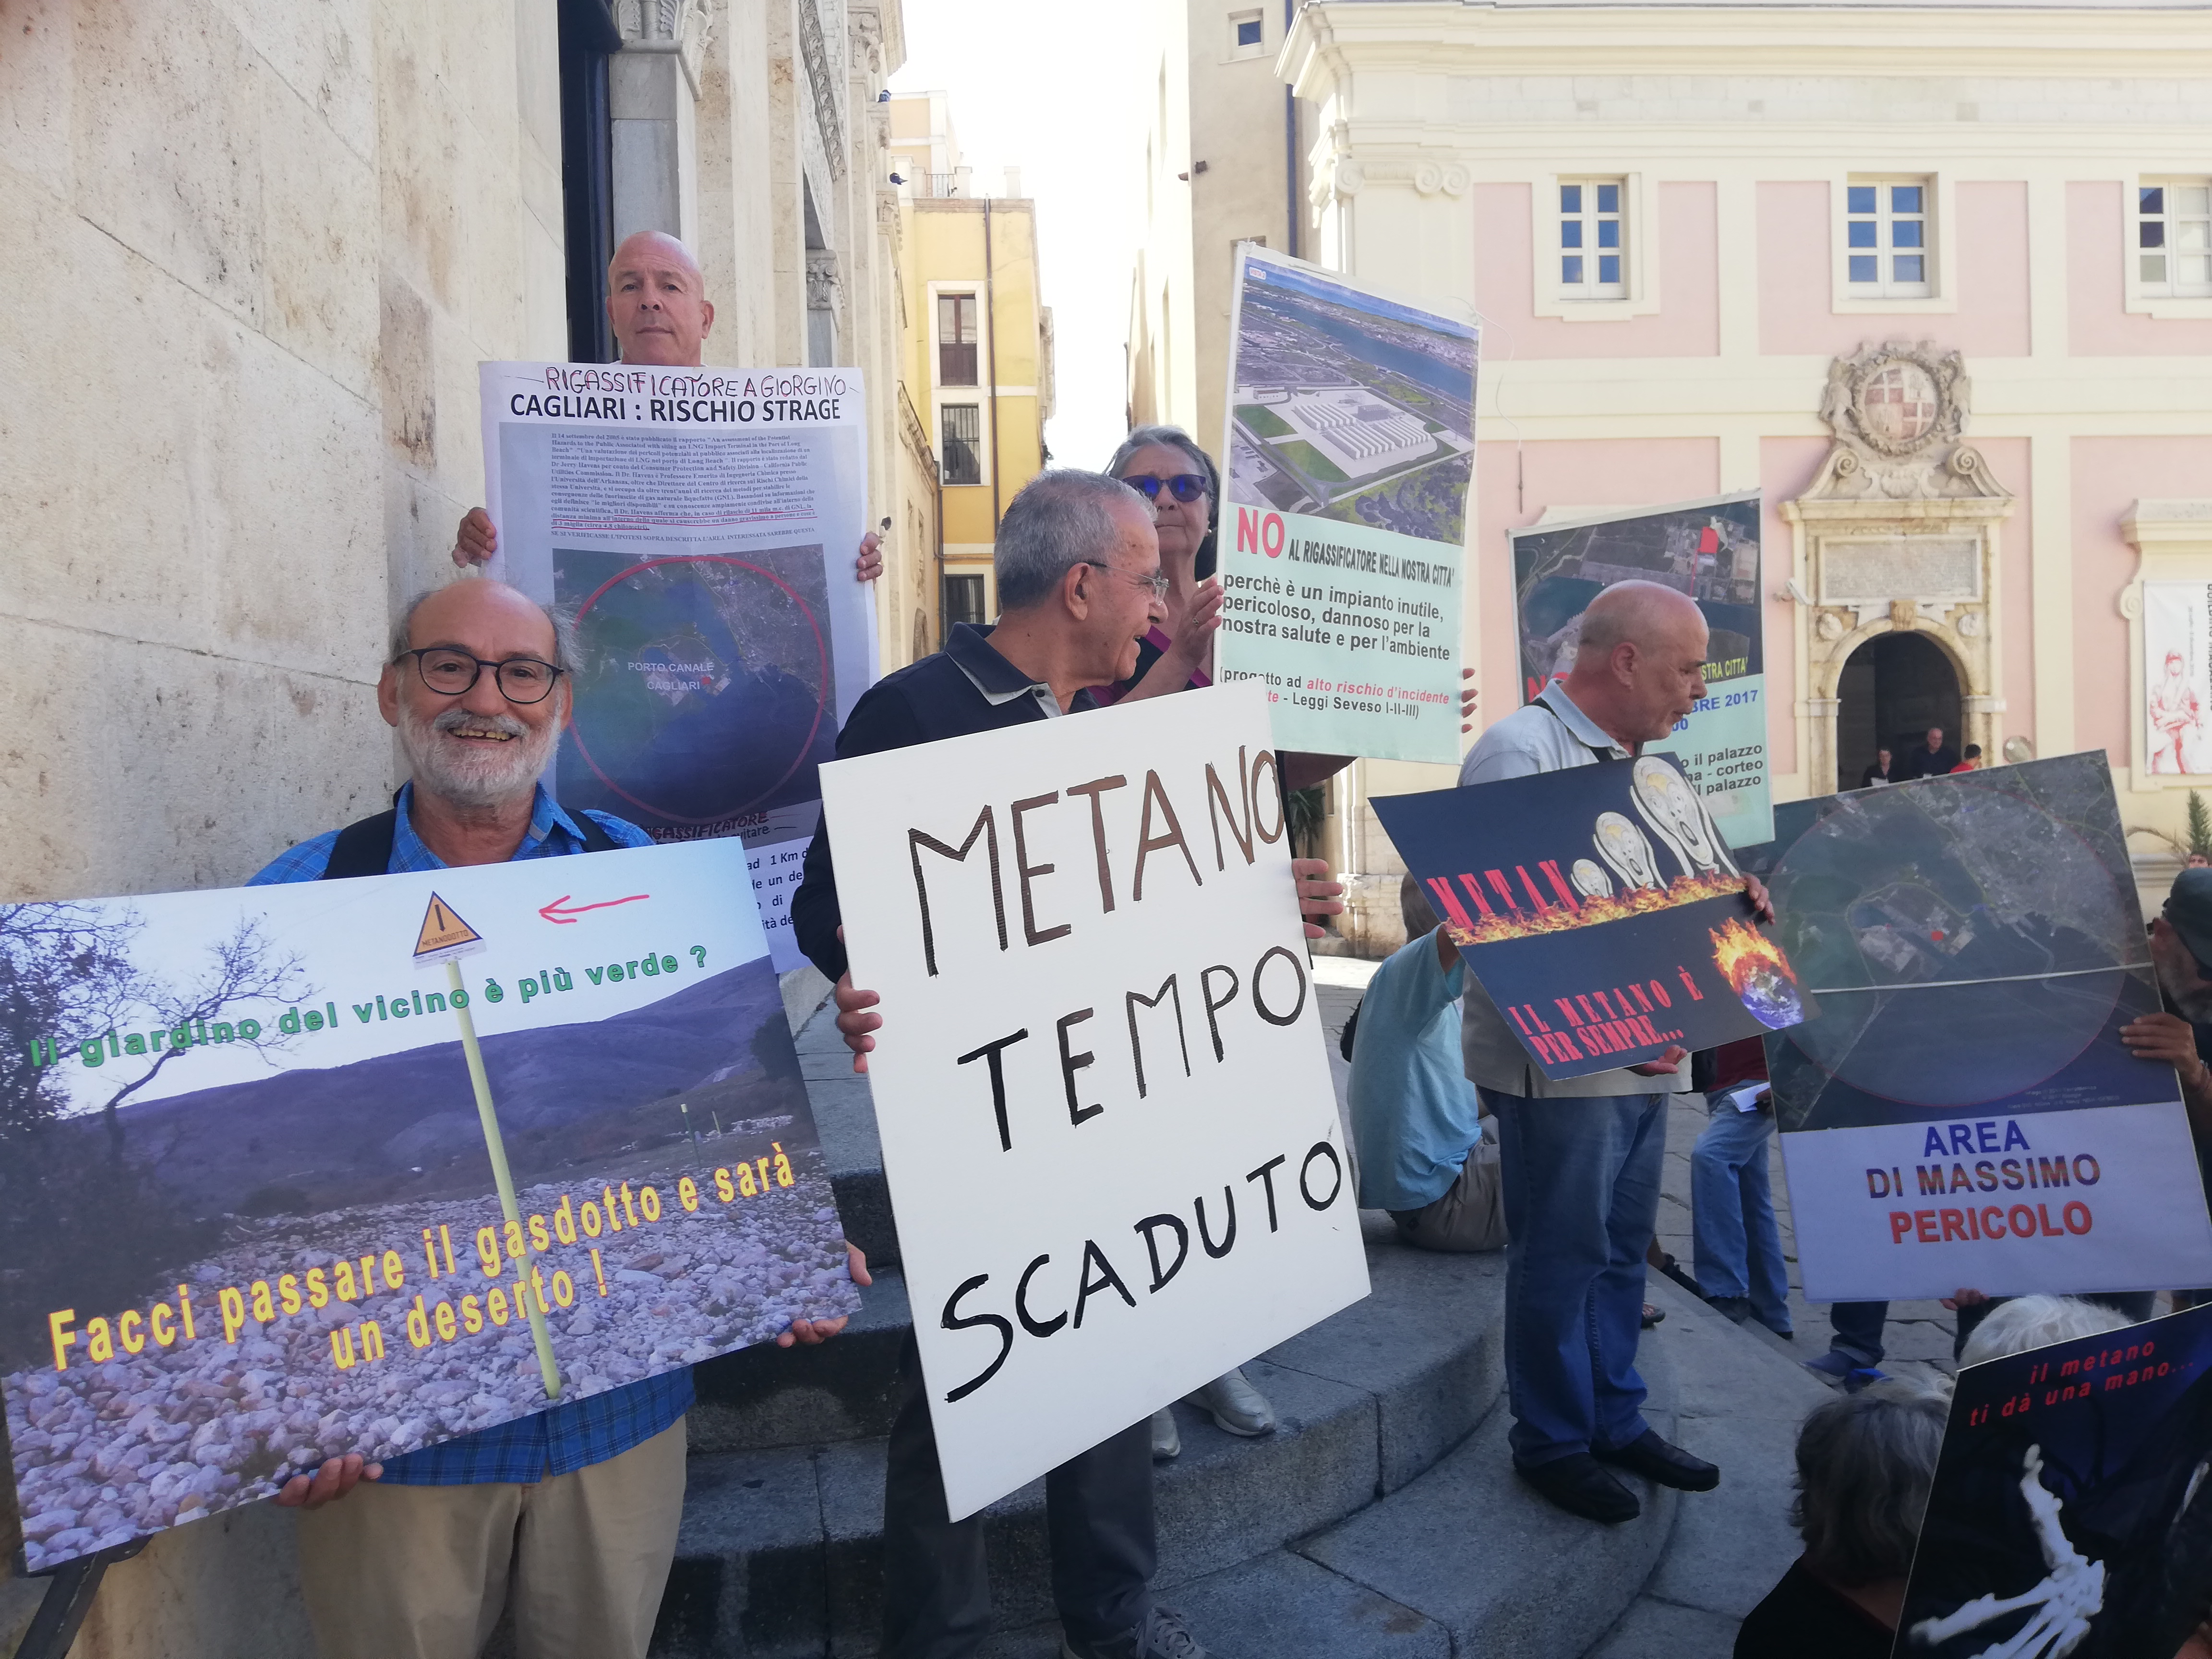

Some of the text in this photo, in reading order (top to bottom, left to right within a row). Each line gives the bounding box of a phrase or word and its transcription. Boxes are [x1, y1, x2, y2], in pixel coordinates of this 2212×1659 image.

[545, 367, 846, 397] RIGASSIFICATORE A GIORGINO
[510, 393, 626, 421] CAGLIARI
[650, 398, 755, 422] RISCHIO
[762, 398, 841, 422] STRAGE
[1237, 507, 1285, 559] NO
[1288, 538, 1300, 561] AL
[1303, 540, 1377, 573] RIGASSIFICATORE
[1379, 553, 1399, 577] NELLA
[1401, 558, 1430, 583] NOSTRA
[1222, 594, 1430, 638] pericoloso, dannoso per la
[1224, 573, 1444, 623] perchè è un impianto inutile,
[1222, 617, 1451, 661] nostra salute e per l'ambiente
[627, 662, 715, 673] PORTO CANALE
[647, 681, 700, 691] CAGLIARI
[1220, 666, 1450, 705] (protto ad alto rischio d'incidente
[1701, 661, 1723, 680] STRA
[1293, 692, 1328, 710] Leggi
[1333, 696, 1382, 714] Seveso
[1725, 690, 1758, 707] 2017
[1695, 753, 1702, 765] il
[1708, 745, 1762, 766] palazzo
[1717, 760, 1763, 776] corteo
[1707, 776, 1761, 796] palazzo
[646, 812, 769, 840] IGASSIFICATORE
[770, 855, 777, 865] 1
[781, 852, 798, 863] Km
[907, 745, 1285, 977] METANO
[769, 876, 782, 886] un
[772, 895, 783, 906] di
[30, 1038, 58, 1067] Il
[80, 1019, 261, 1067] giardino
[279, 1002, 337, 1034] del
[353, 989, 469, 1023] vicino
[484, 978, 503, 1003] è
[518, 967, 573, 1003] più
[585, 953, 679, 985] verde
[1508, 1004, 1551, 1035] IL
[1553, 979, 1672, 1026] METANO
[956, 945, 1307, 1153] TEMPO
[1528, 1015, 1684, 1064] PER SEMPRE...
[1923, 1120, 2031, 1157] AREA
[1865, 1153, 2101, 1199] DI MASSIMO
[1889, 1200, 2093, 1244] PERICOLO
[49, 1142, 795, 1371] Facci passare il gasdotto e sarà
[940, 1140, 1342, 1404] SCADUTO
[329, 1319, 385, 1370] un
[406, 1265, 574, 1348] deserto
[2030, 1341, 2155, 1384] il metano
[1970, 1362, 2193, 1426] ti dà una mano...
